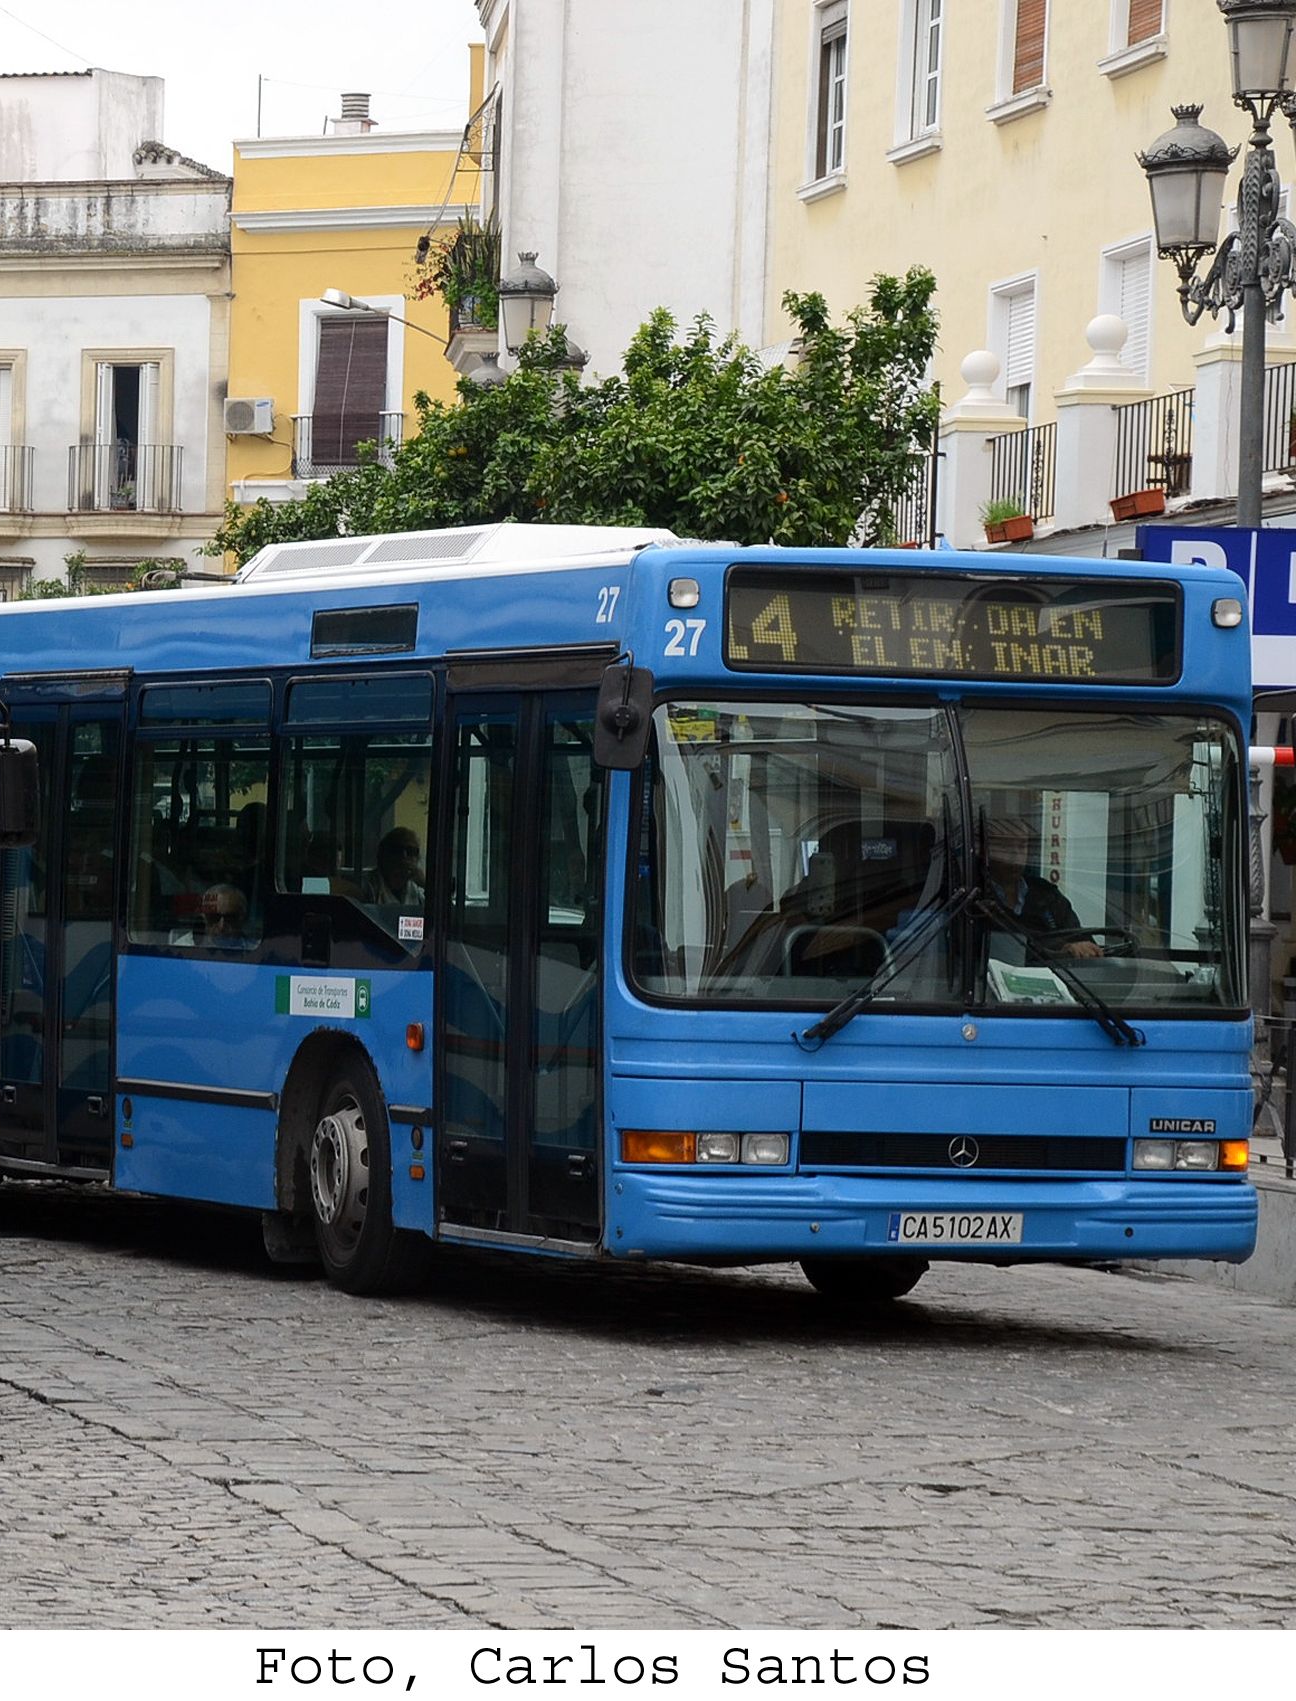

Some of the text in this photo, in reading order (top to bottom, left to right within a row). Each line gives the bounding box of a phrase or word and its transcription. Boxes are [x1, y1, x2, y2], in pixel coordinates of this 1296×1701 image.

[596, 586, 621, 624] 27
[664, 618, 707, 657] 27
[851, 634, 897, 667] EL
[1152, 1120, 1215, 1133] UNICAR
